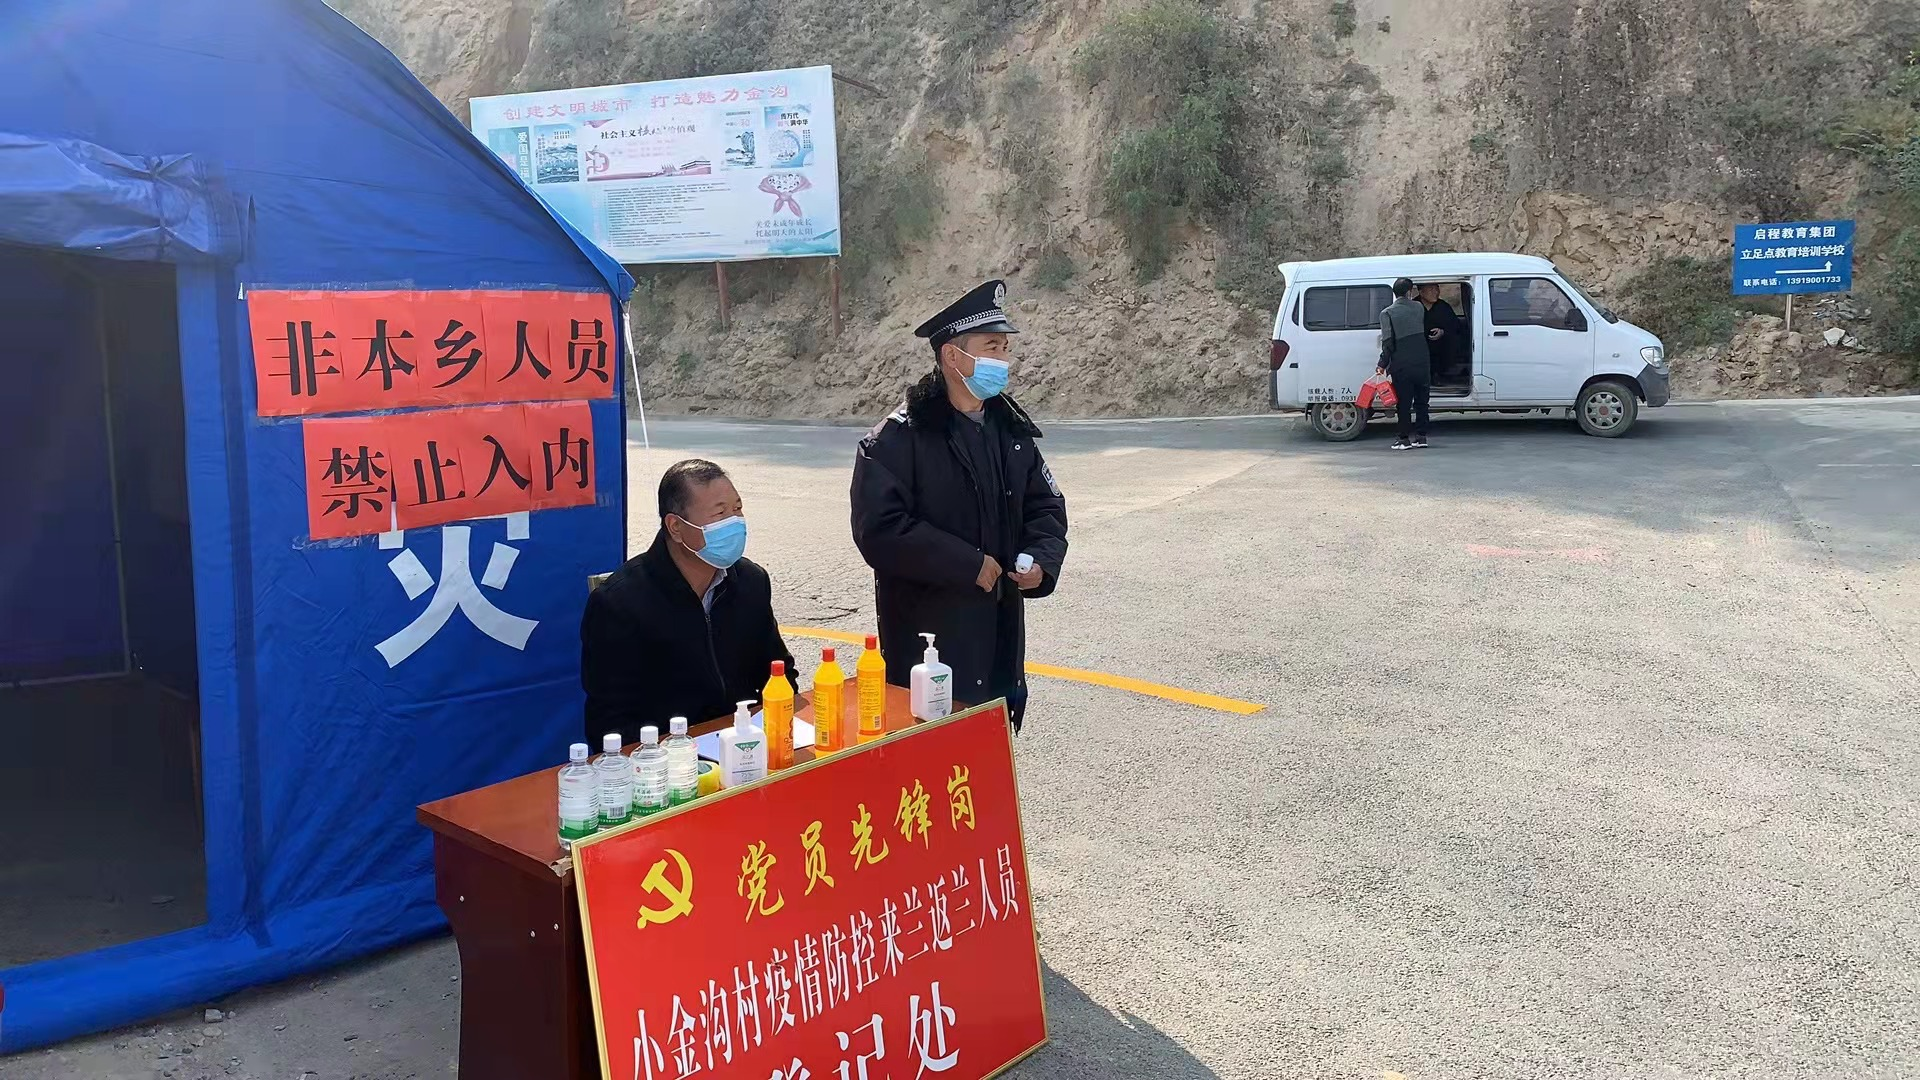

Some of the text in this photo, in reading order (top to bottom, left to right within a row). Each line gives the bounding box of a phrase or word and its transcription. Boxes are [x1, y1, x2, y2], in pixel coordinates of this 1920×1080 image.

[503, 84, 789, 120] 创建文明城市 打造魅力金沟
[1740, 244, 1845, 260] 立足点教育培训学校
[1753, 225, 1836, 240] 启程教育集团
[265, 318, 611, 396] 非本乡人员
[318, 427, 590, 519] 禁止入内
[736, 764, 976, 923] 党员先锋岗
[632, 843, 1020, 1080] 小金沟村疫情防控来兰返兰人员
[768, 981, 960, 1080] 记处
